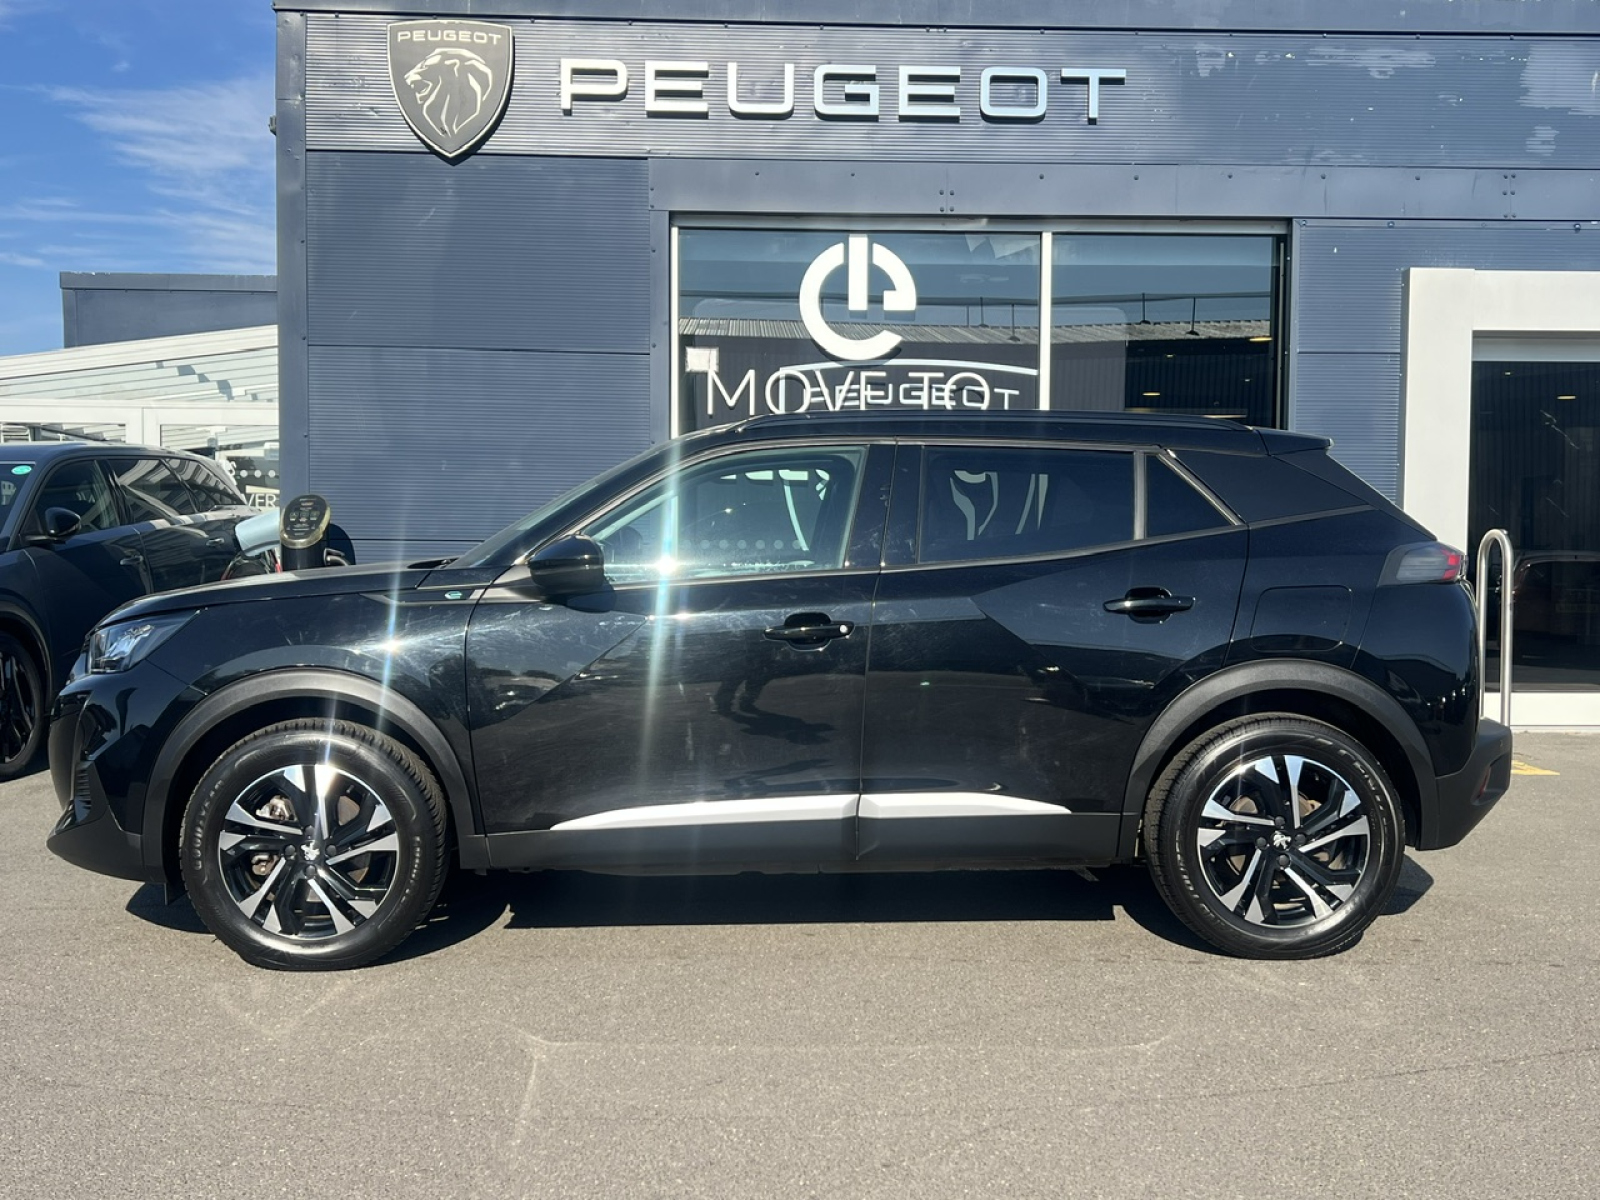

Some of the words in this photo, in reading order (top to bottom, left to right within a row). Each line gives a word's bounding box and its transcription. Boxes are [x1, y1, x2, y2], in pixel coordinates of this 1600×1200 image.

[397, 29, 502, 45] PEUGEOT
[559, 57, 1127, 121] PEUGEOT
[908, 371, 991, 411] TO
